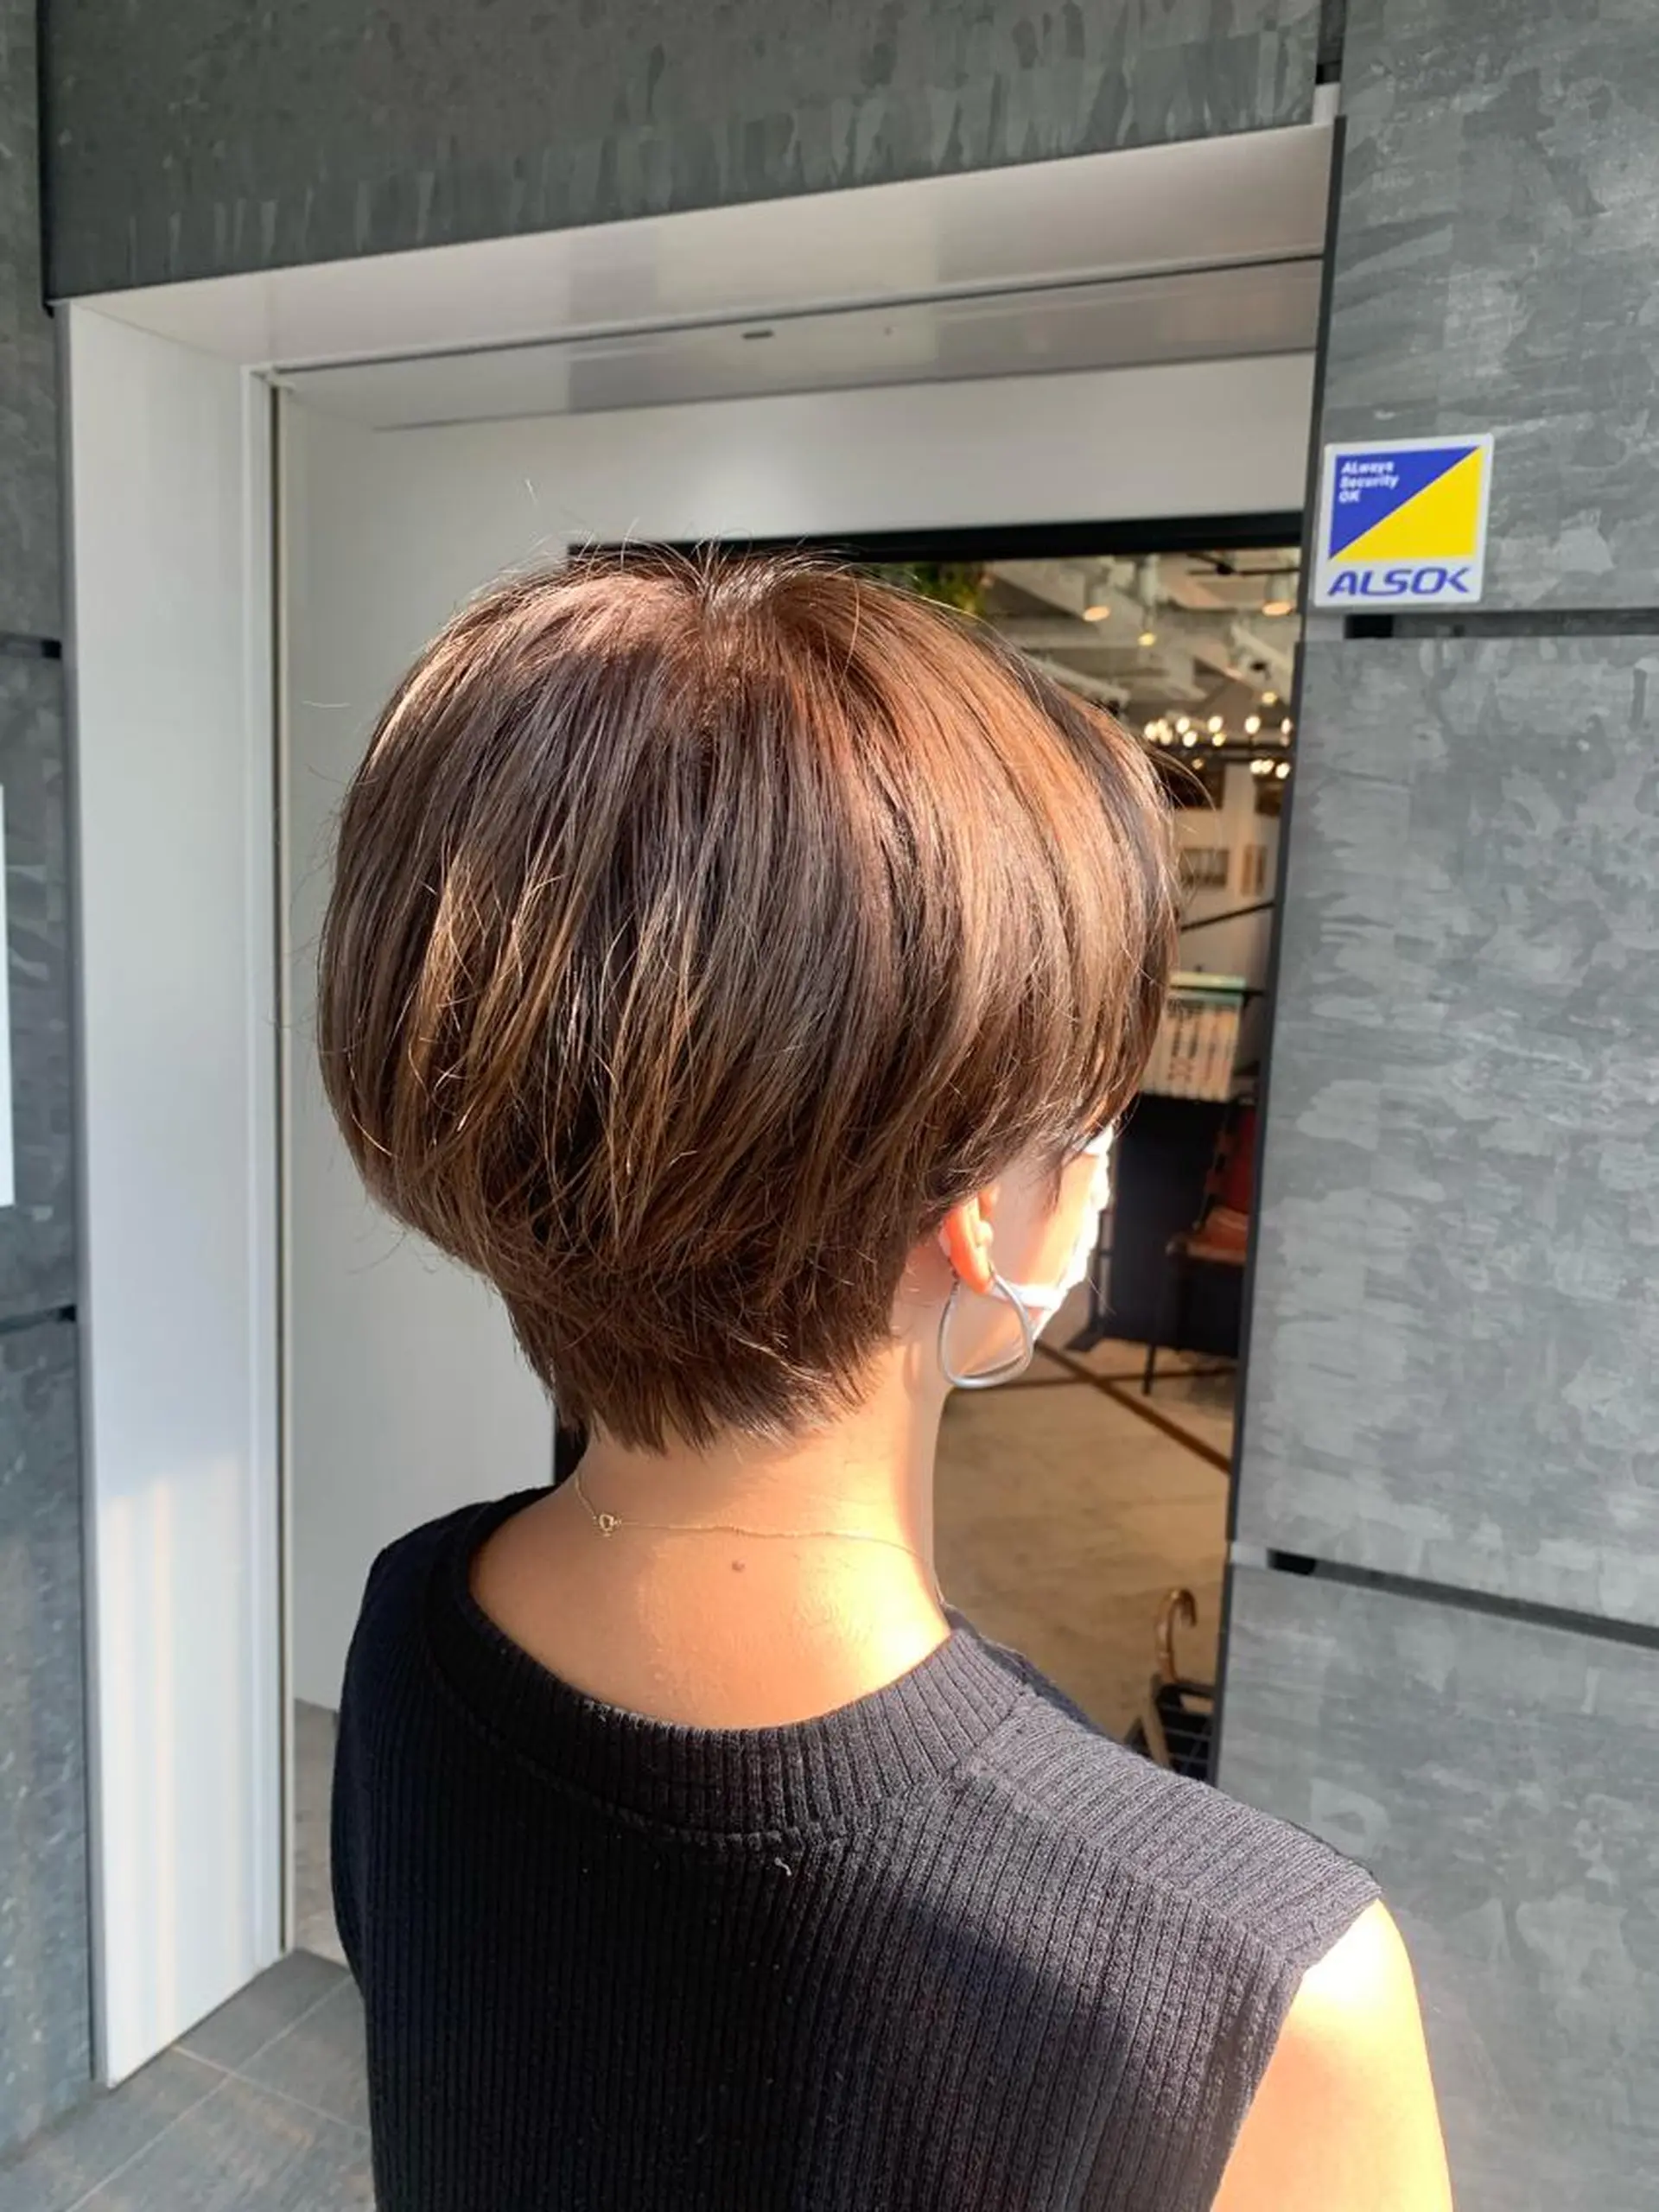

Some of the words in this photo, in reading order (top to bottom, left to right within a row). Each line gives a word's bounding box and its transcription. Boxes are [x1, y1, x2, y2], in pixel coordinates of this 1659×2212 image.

[1339, 475, 1400, 490] Security
[1338, 490, 1361, 504] OK
[1327, 567, 1471, 597] ALSOK
